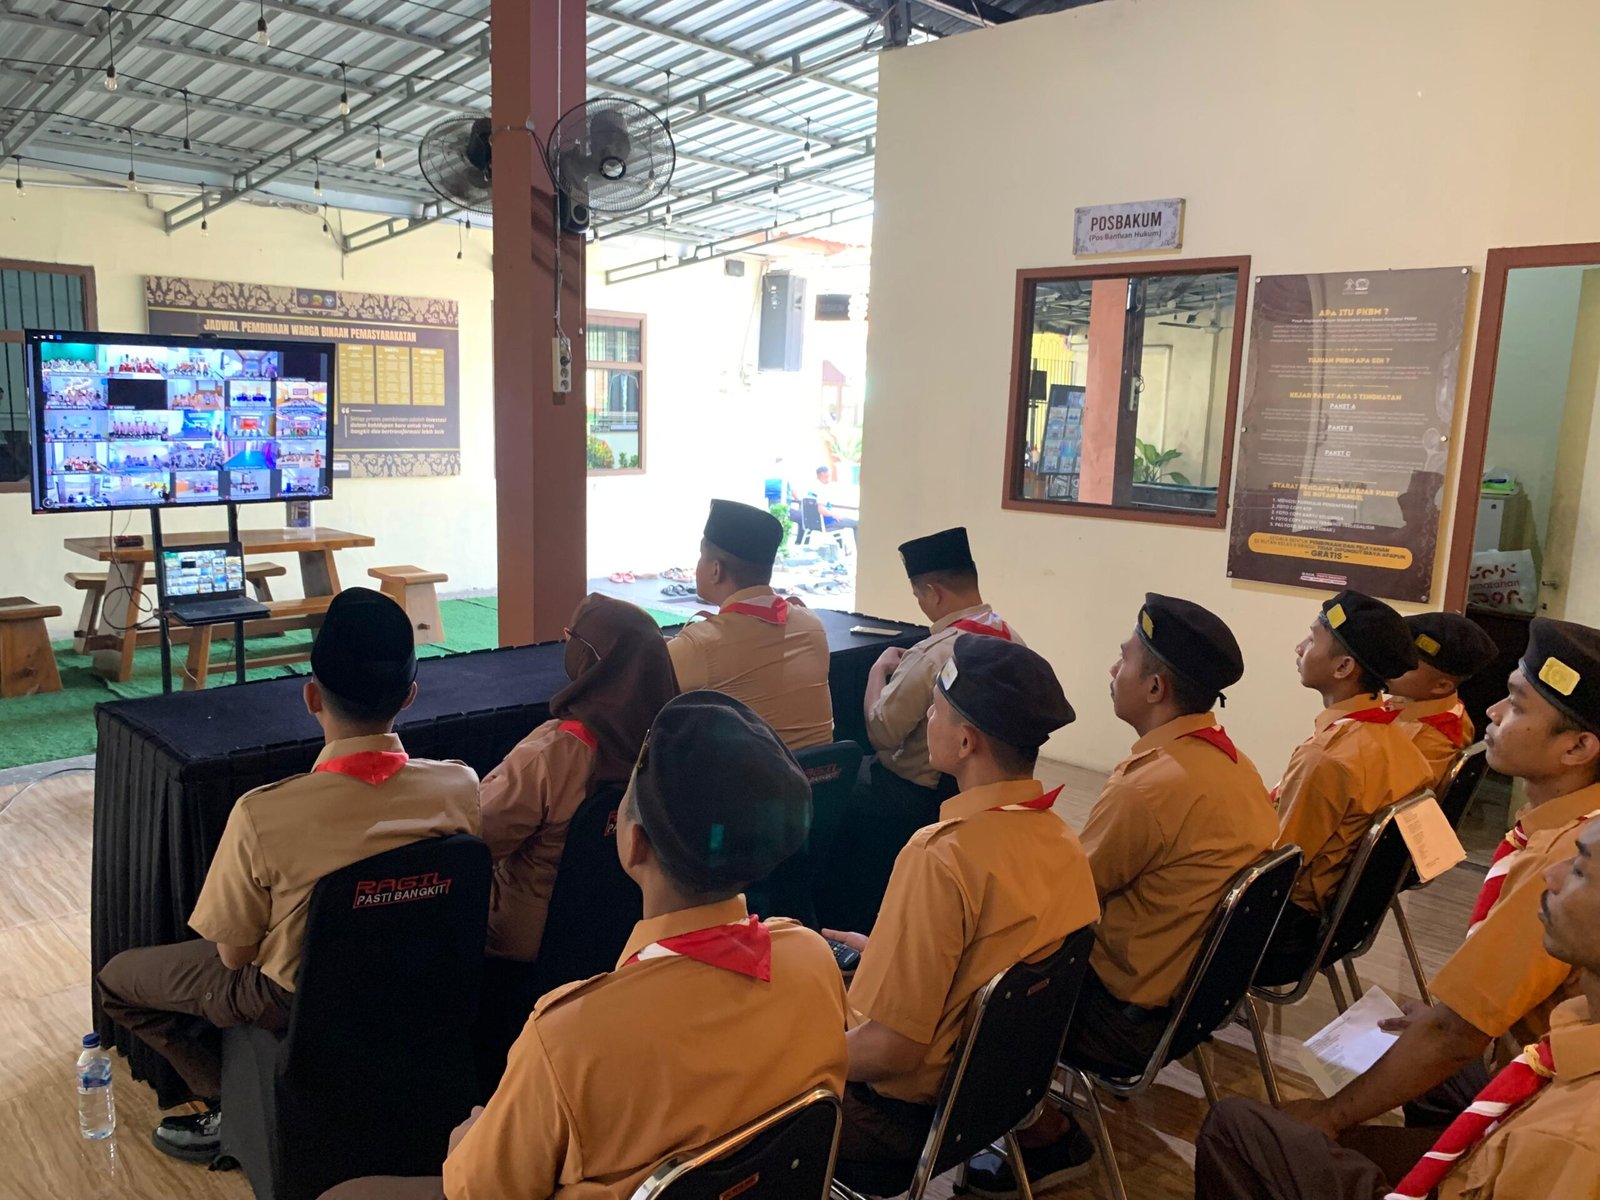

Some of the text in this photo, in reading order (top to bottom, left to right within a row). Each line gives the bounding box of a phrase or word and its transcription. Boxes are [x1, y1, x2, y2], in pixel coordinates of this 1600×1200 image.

[1090, 211, 1162, 232] POSBAKUM
[1089, 229, 1162, 242] (Pos Bantuan Hukum)
[1318, 309, 1337, 317] APA
[1338, 308, 1354, 316] ITU
[1356, 308, 1381, 316] PKBM
[203, 318, 417, 343] JADWAL PEMBINAAN WARGA BINAAN PEMASYARAKATAN
[1311, 550, 1343, 560] GRATIS
[356, 883, 447, 906] PASTI BANGKIT
